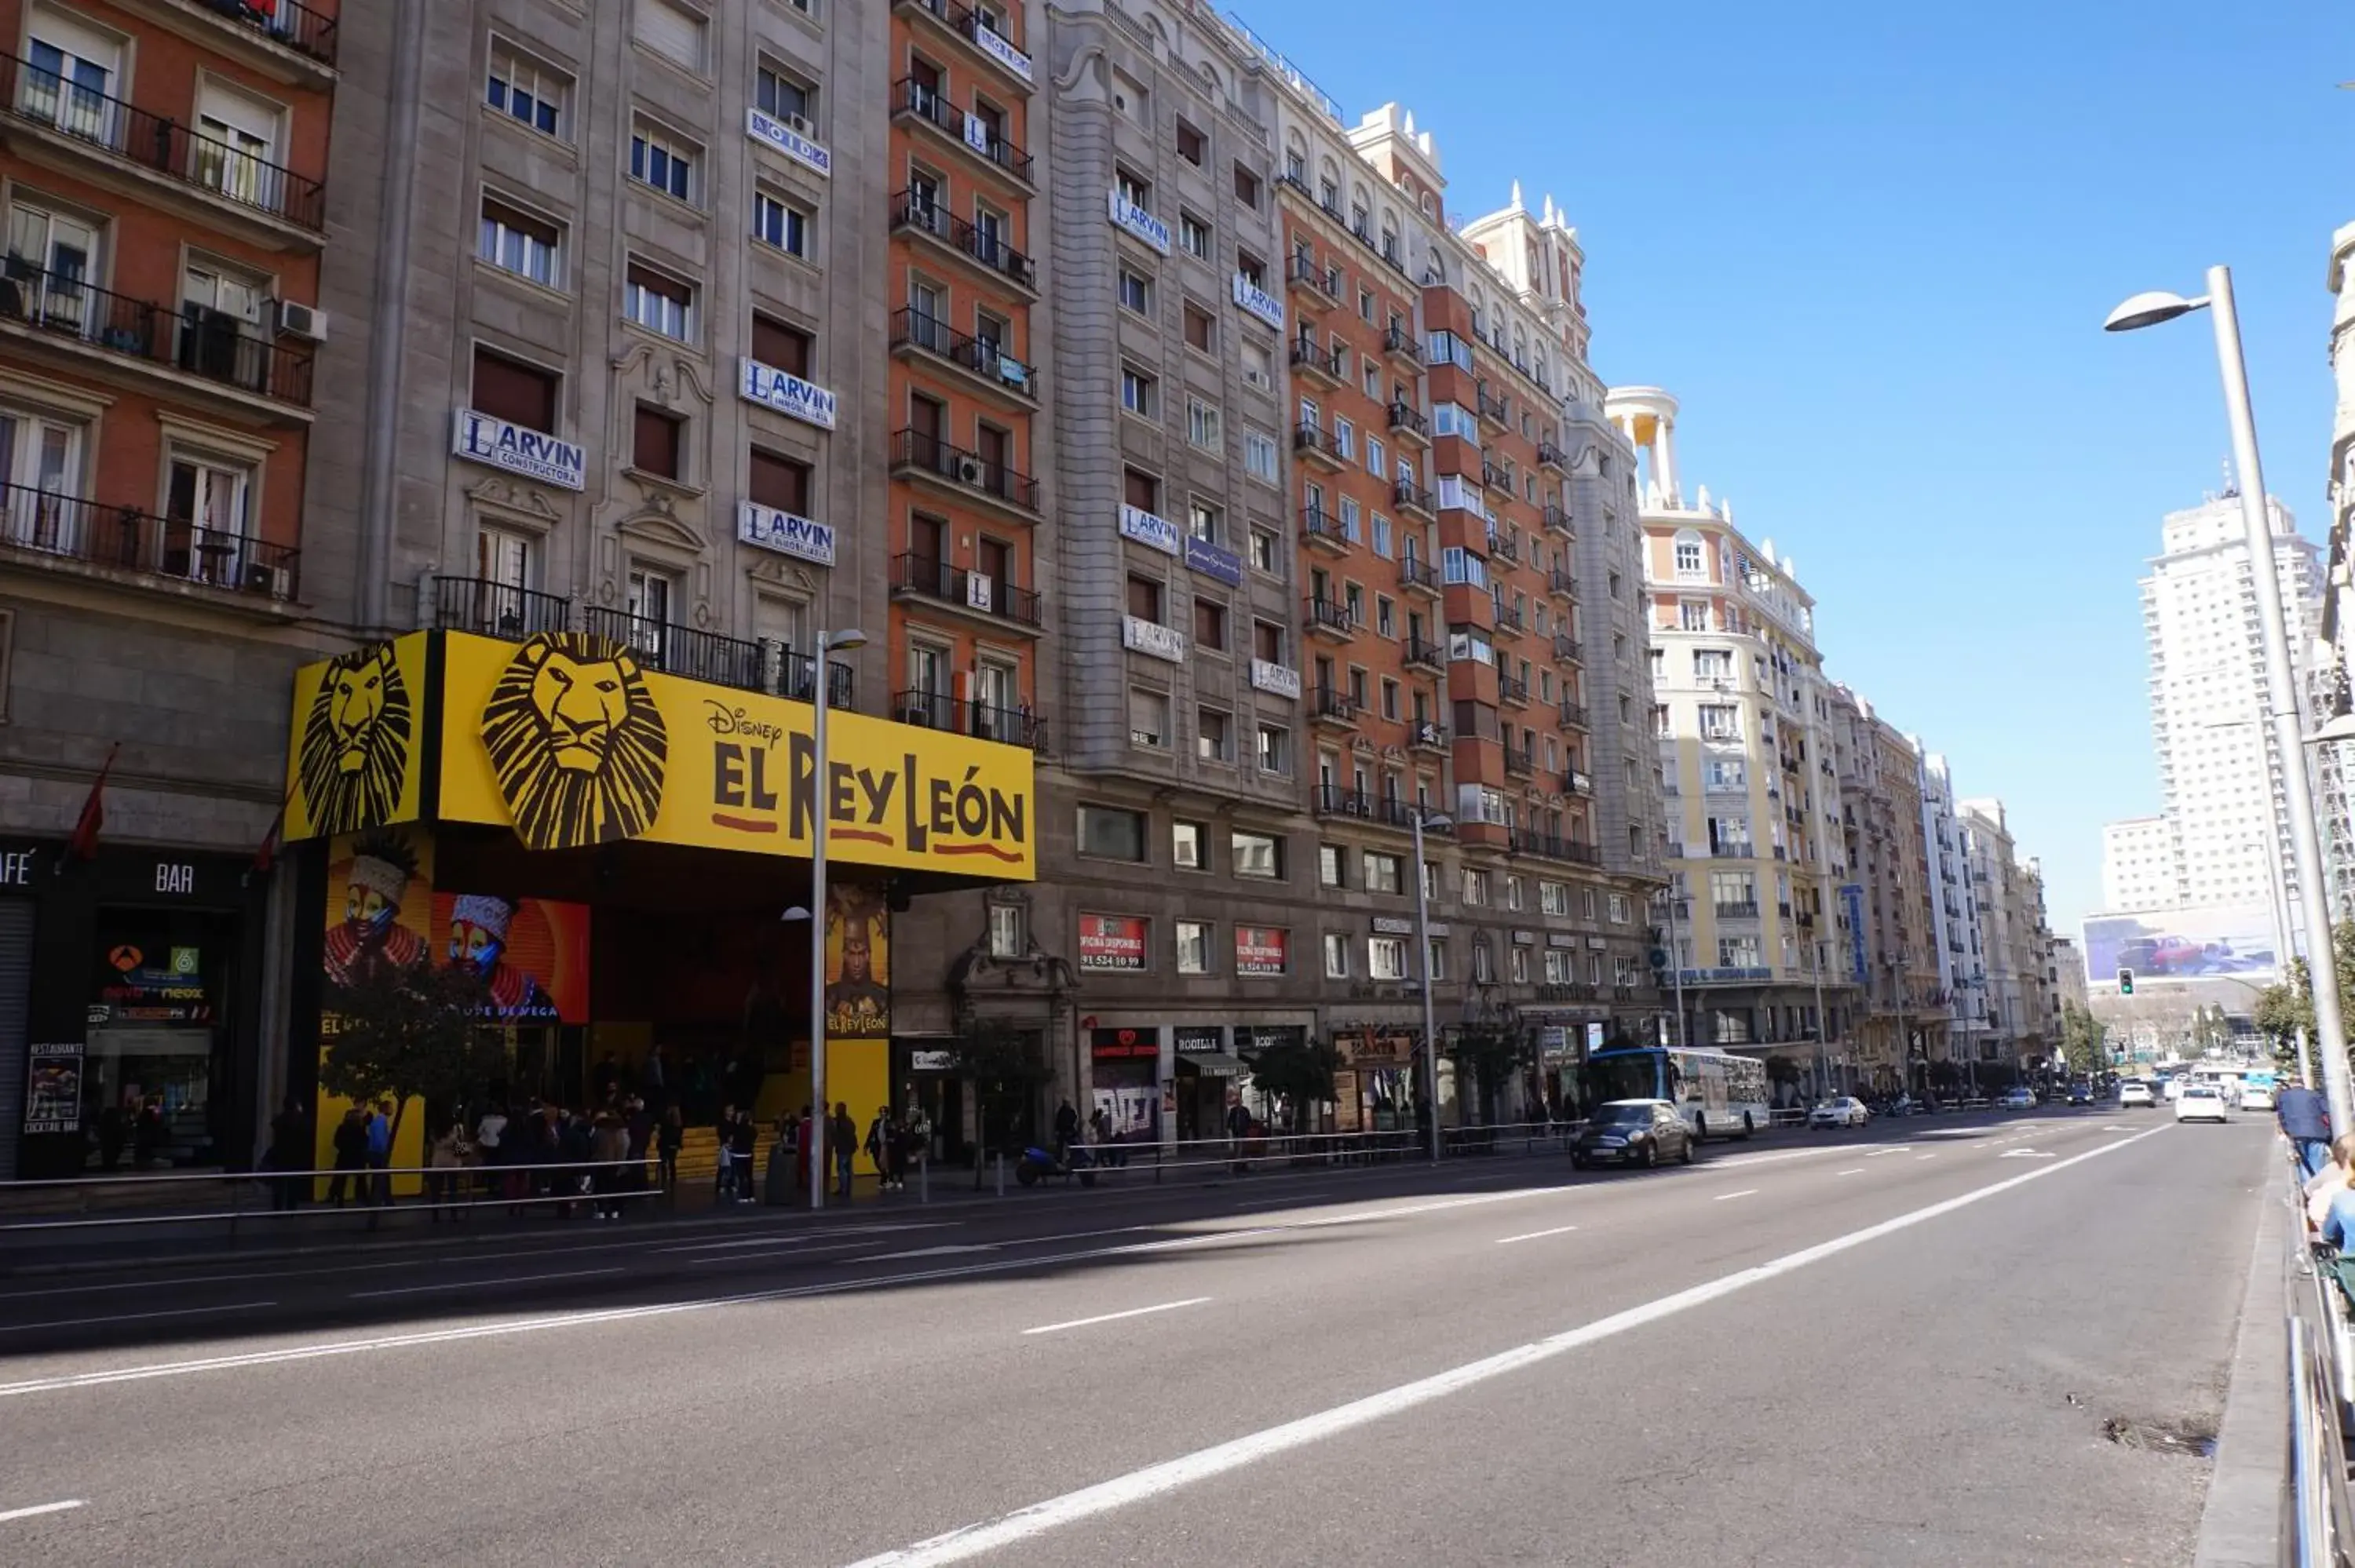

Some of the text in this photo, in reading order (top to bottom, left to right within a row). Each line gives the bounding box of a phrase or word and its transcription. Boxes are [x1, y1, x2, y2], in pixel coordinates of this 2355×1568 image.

[750, 364, 833, 413] LARVIN
[468, 418, 582, 471] LARVIN
[502, 454, 575, 483] CONSTRUCTORA
[750, 507, 832, 548] LARVIN
[1126, 509, 1176, 542] LARVIN
[714, 731, 1024, 853] EL REY LEÓN
[0, 848, 193, 893] FÉ BAR
